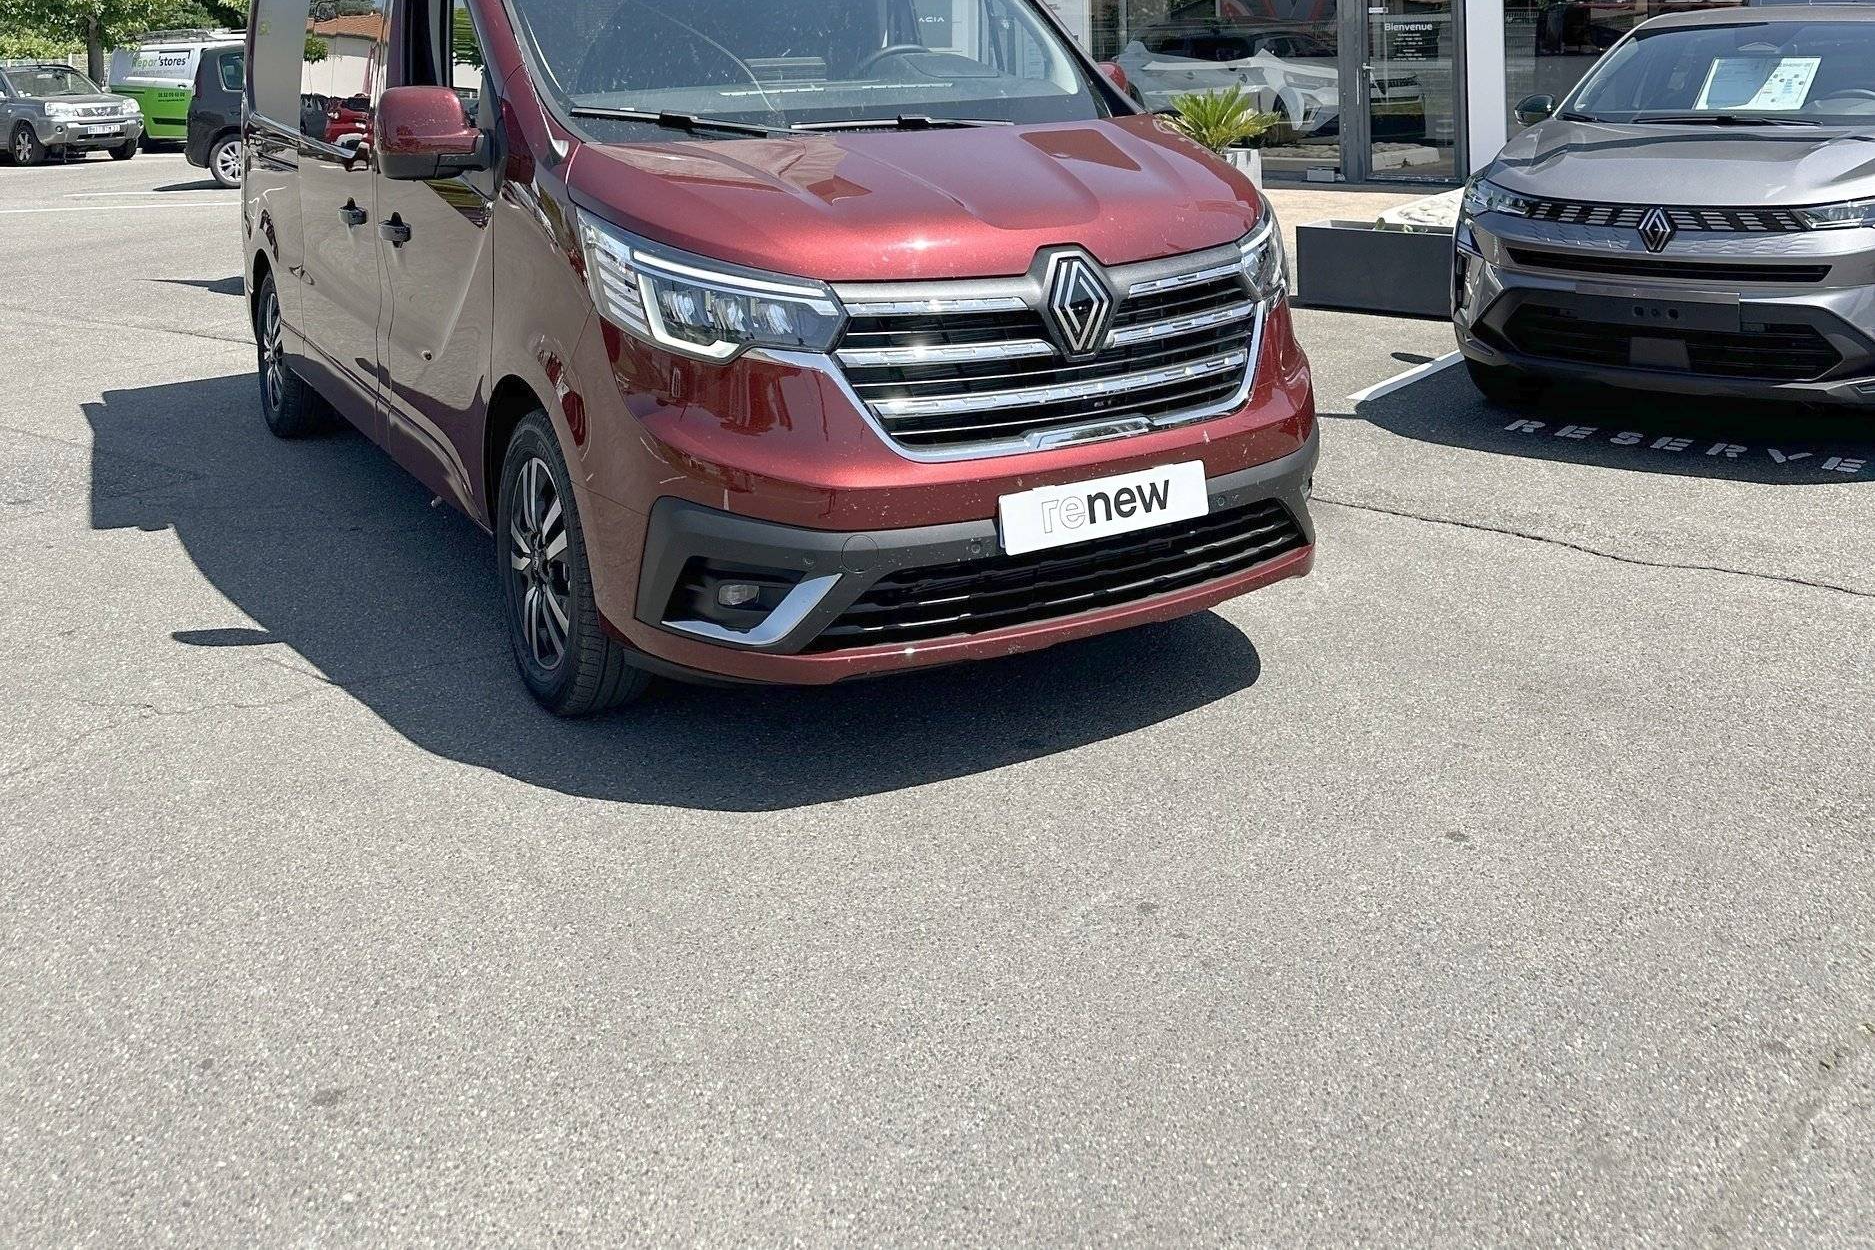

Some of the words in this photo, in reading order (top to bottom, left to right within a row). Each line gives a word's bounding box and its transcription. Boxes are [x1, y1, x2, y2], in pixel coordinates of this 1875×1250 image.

[1384, 22, 1433, 31] Bienvenue
[1503, 418, 1868, 474] RESERVE
[1040, 479, 1170, 535] renew
